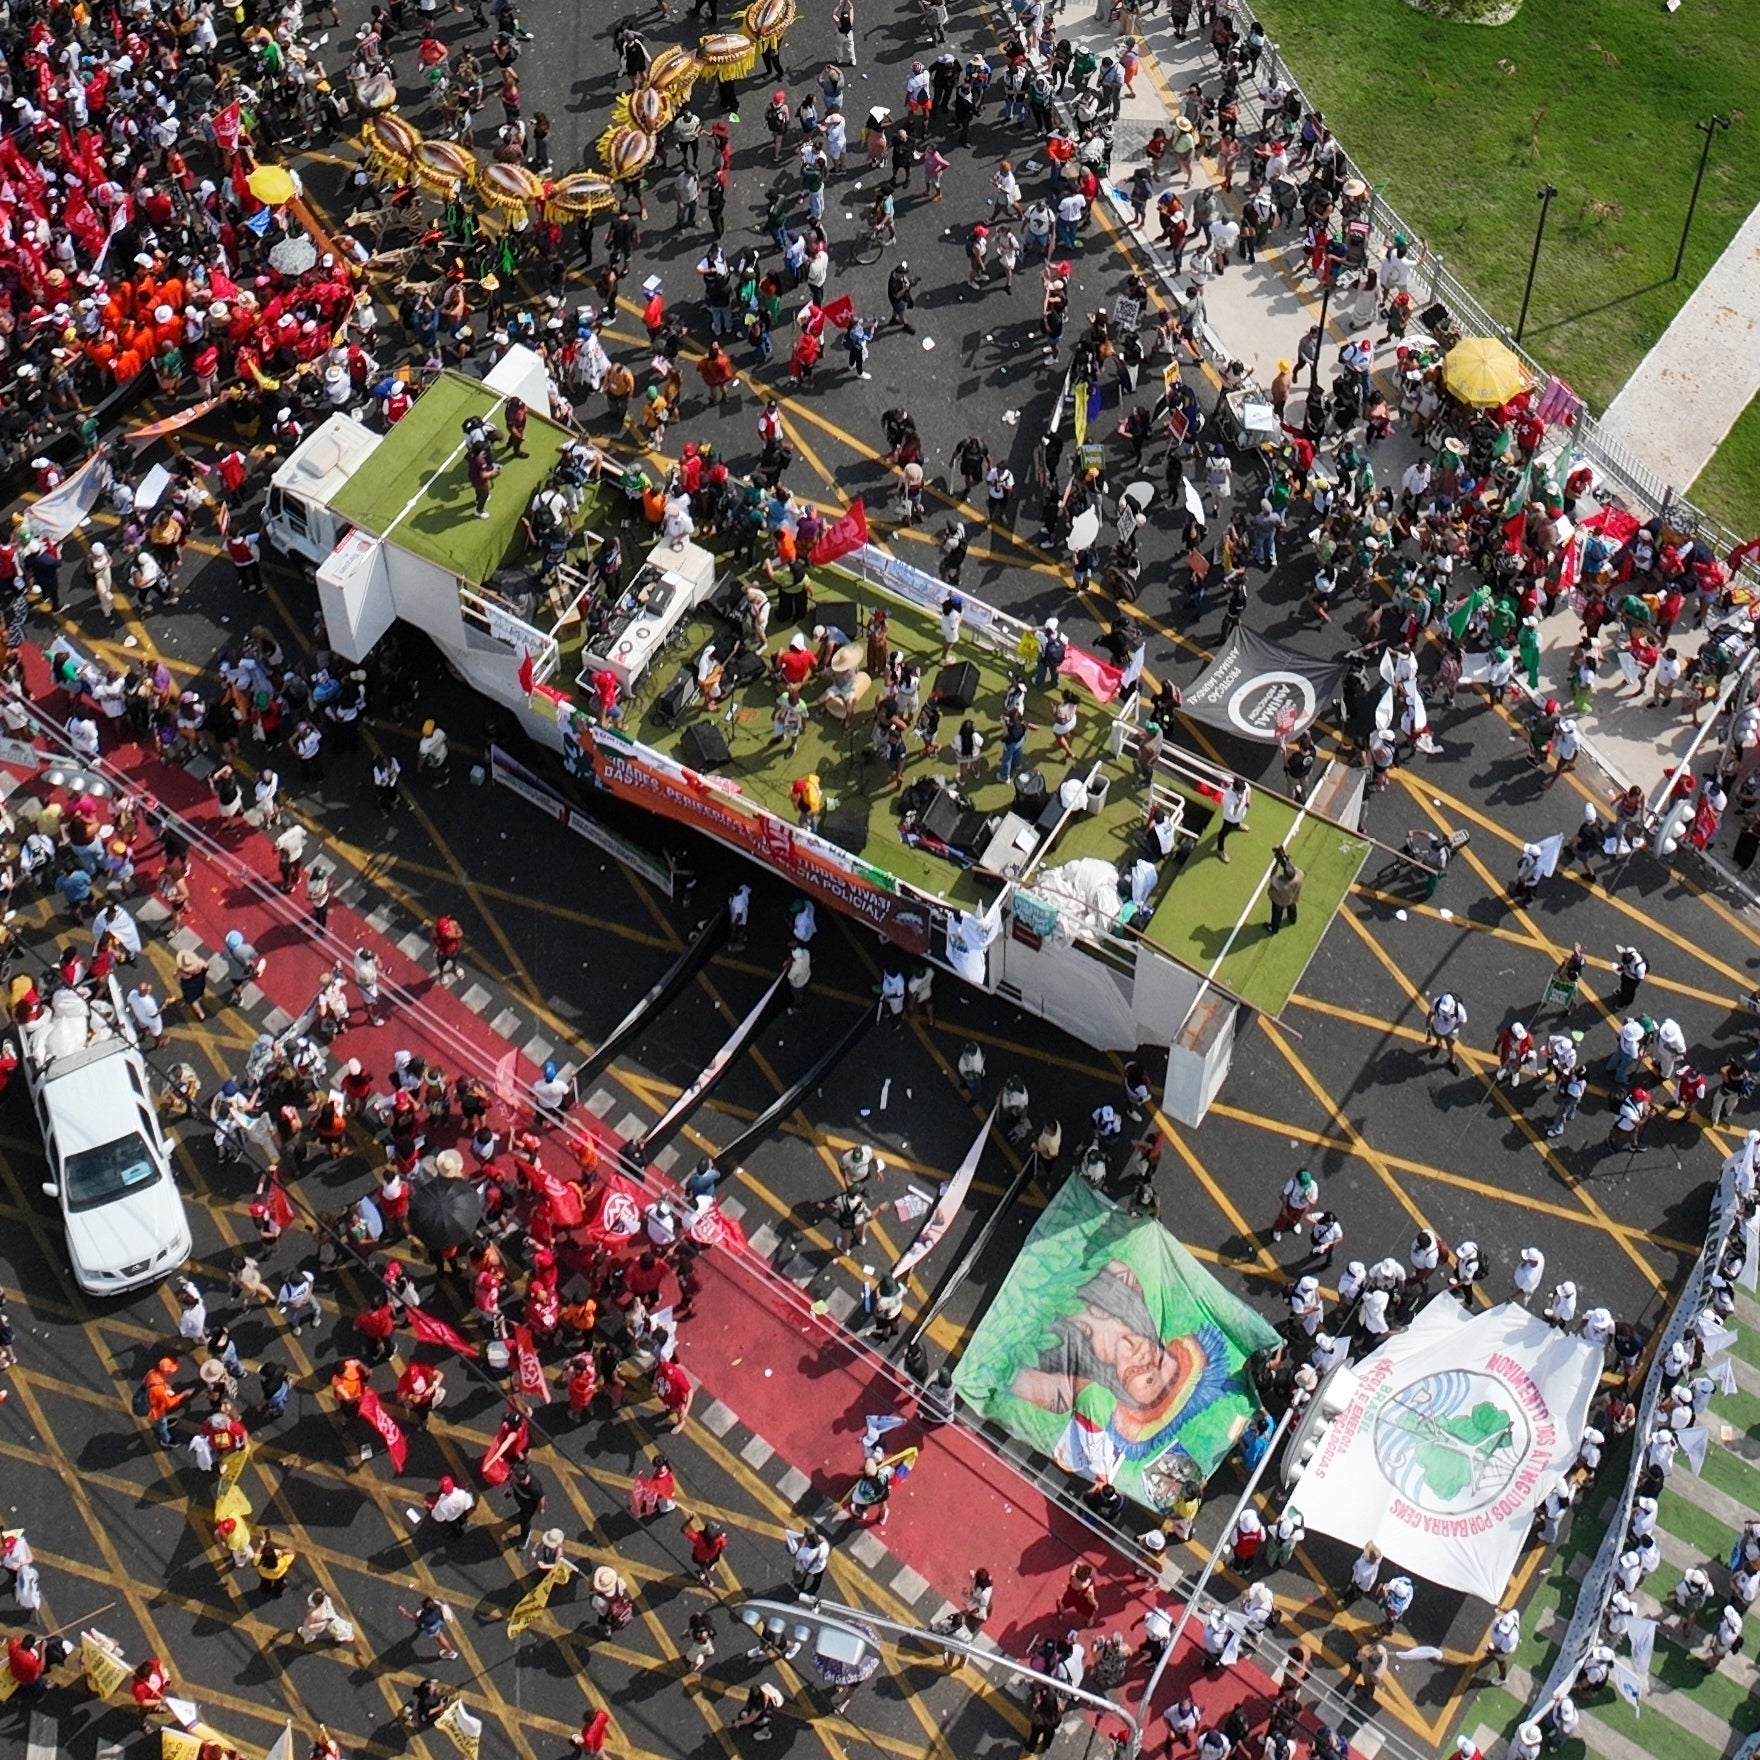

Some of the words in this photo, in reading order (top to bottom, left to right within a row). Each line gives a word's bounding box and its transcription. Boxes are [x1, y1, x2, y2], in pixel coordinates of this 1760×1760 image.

[1213, 646, 1240, 680] ANIMAL
[1207, 666, 1241, 704] PROTEÇÃO
[1255, 683, 1291, 726] ANIMAL
[822, 878, 888, 923] POLICIAL!
[849, 882, 893, 914] VIVAS!
[1357, 1384, 1393, 1433] BRASIL
[1536, 1423, 1556, 1446] DOS
[1469, 1514, 1493, 1537] POR
